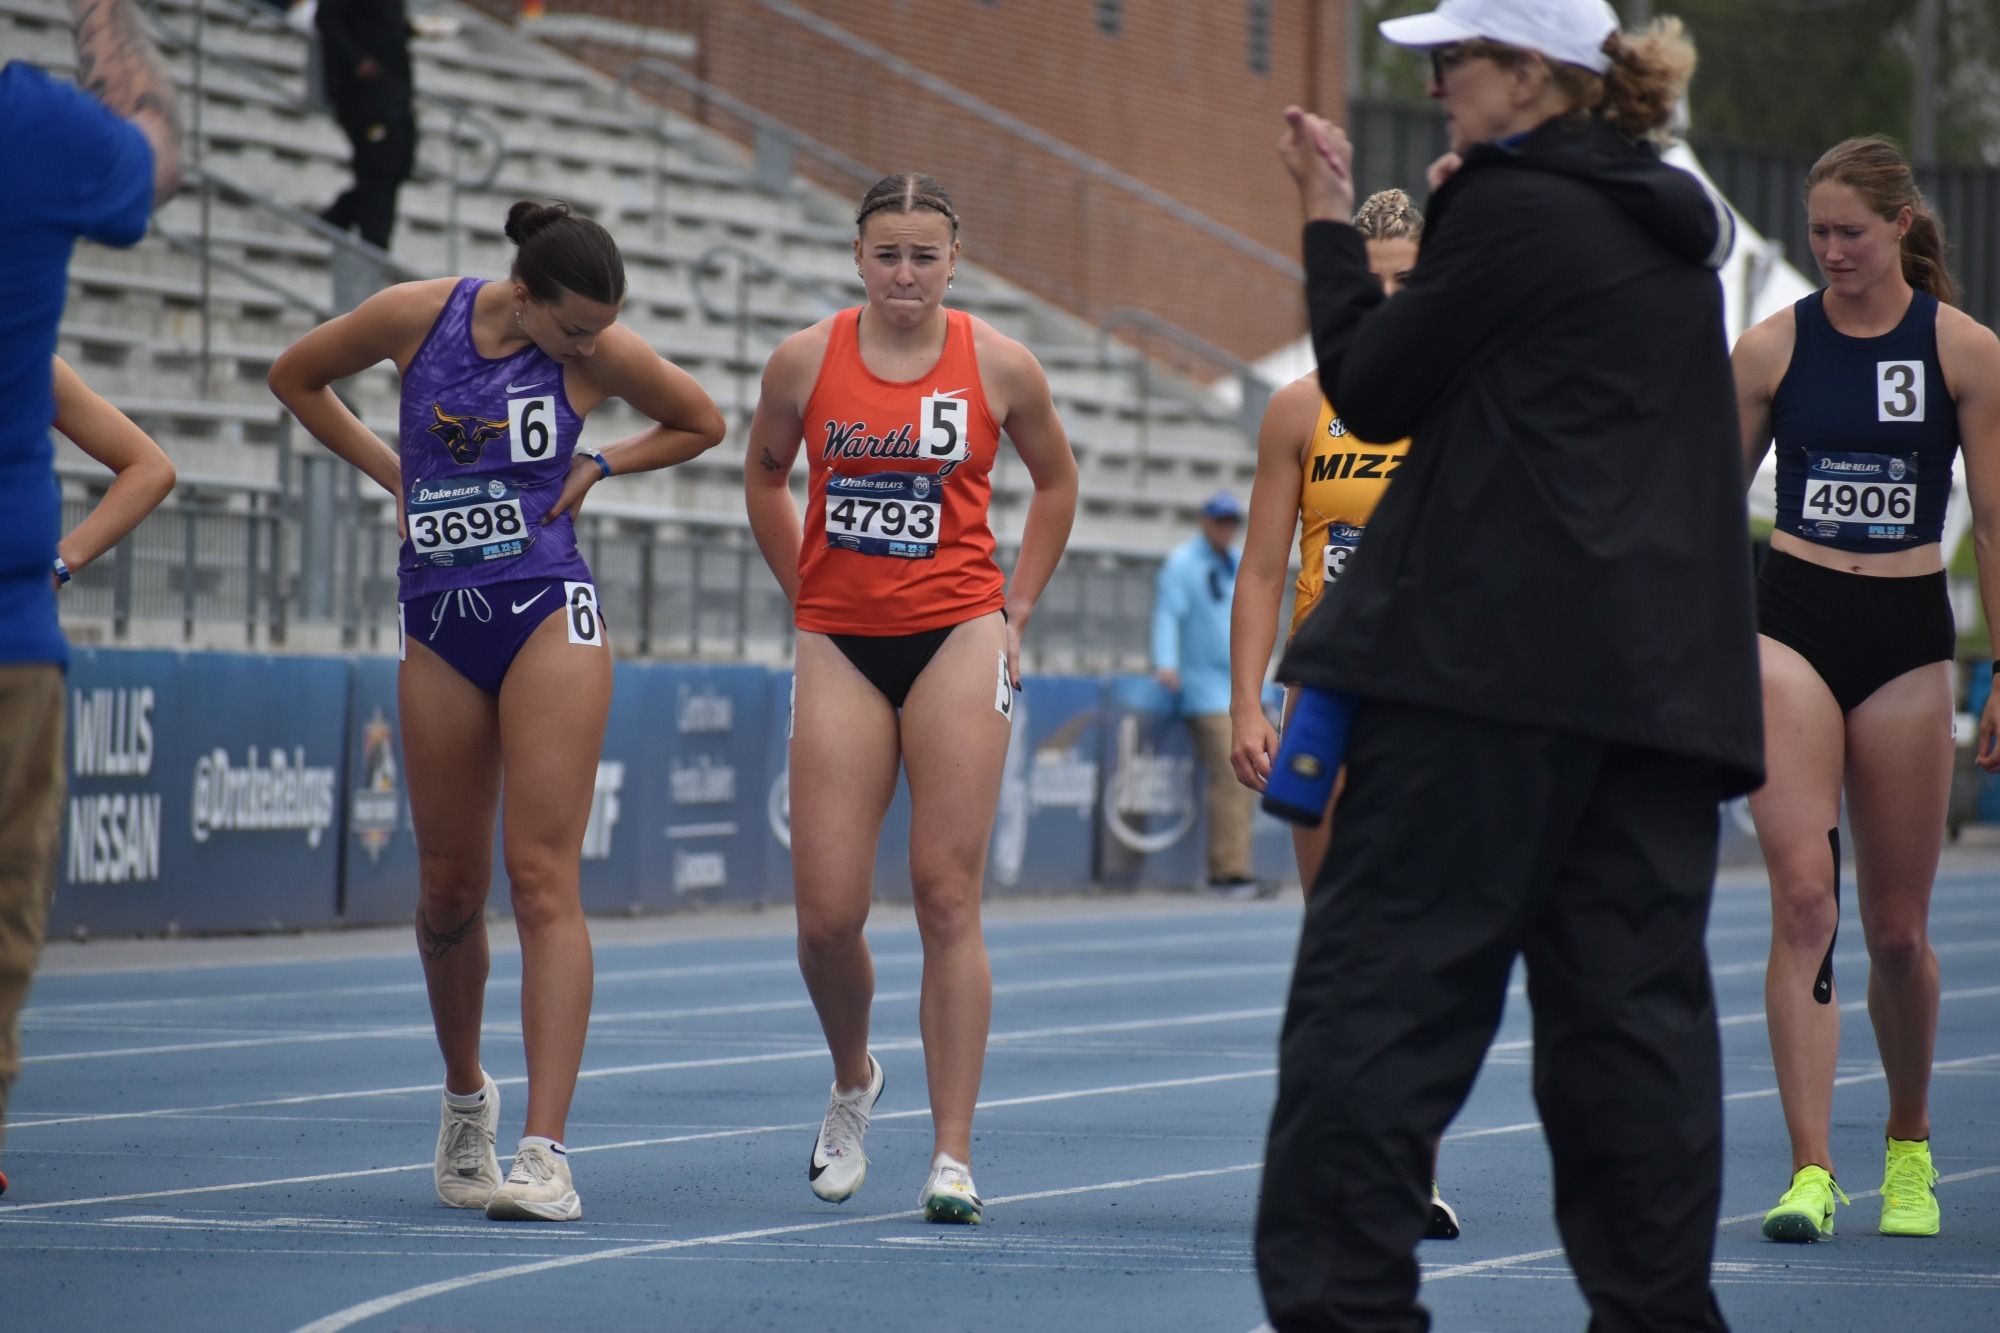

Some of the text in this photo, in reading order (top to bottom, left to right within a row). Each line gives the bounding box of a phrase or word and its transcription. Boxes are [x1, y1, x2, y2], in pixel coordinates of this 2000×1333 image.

[1883, 364, 1917, 418] 3
[520, 400, 549, 458] 6
[930, 400, 958, 456] 5
[839, 477, 904, 490] Drake RELAYS
[915, 482, 928, 491] 100
[1820, 457, 1881, 472] Drake RELAYS
[419, 485, 480, 502] Drake RELAYS
[1809, 484, 1911, 519] 4906
[415, 503, 521, 548] 3698
[830, 498, 935, 539] 4793
[571, 586, 596, 641] 6
[73, 686, 155, 777] WILLIS
[67, 793, 162, 885] NISSAN
